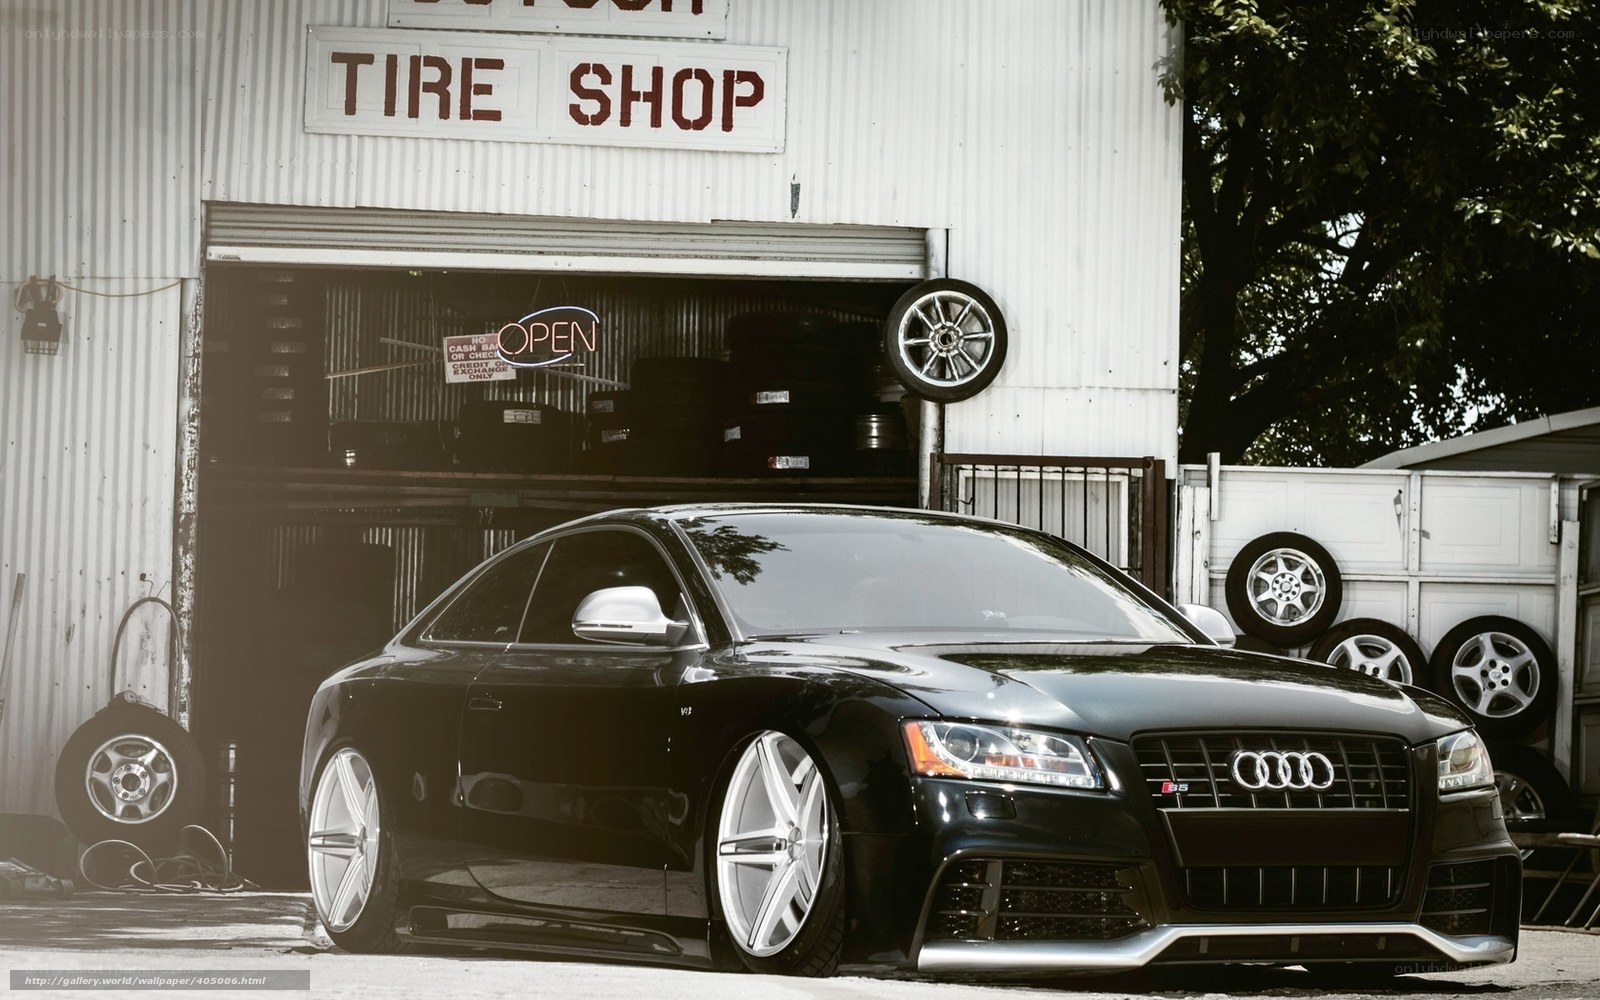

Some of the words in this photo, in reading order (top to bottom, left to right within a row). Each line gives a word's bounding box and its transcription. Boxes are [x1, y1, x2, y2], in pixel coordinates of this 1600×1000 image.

[331, 52, 504, 121] TIRE
[568, 62, 765, 132] SHOP
[498, 320, 596, 355] OPEN
[449, 344, 476, 353] CASH
[453, 366, 508, 375] EXCHANGE
[1168, 783, 1189, 792] S5
